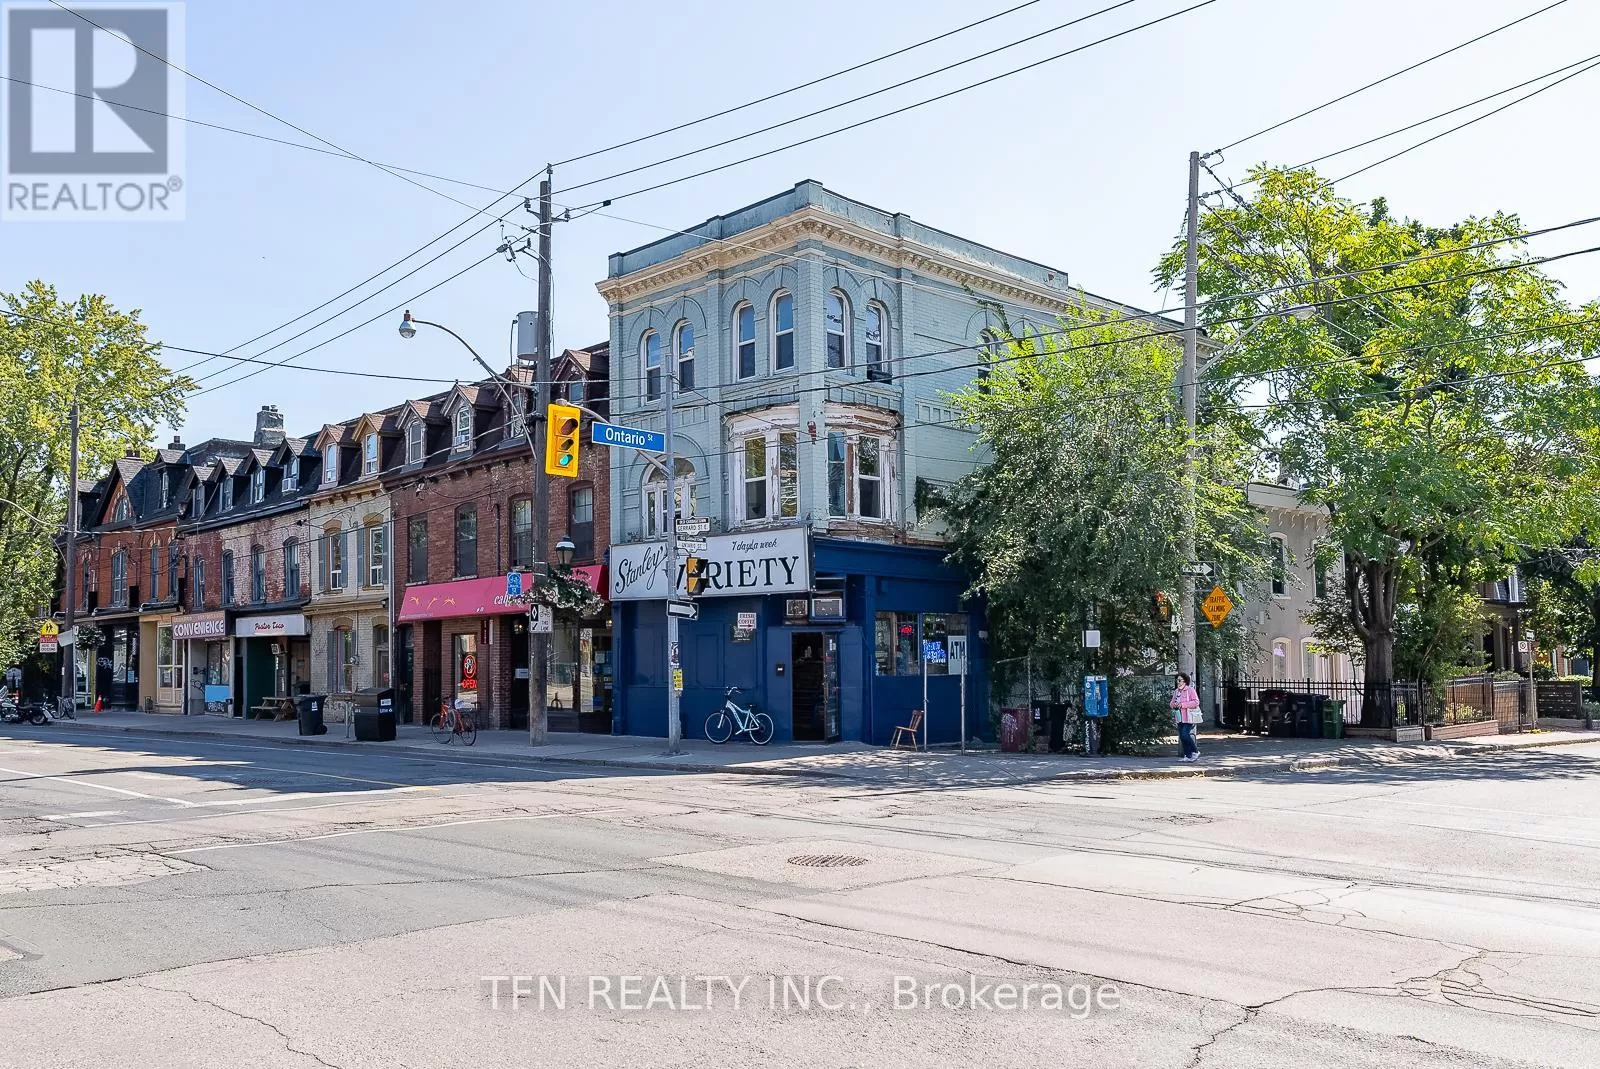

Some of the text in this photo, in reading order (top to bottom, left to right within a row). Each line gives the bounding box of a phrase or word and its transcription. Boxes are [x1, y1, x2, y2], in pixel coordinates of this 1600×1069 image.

[605, 427, 653, 446] Ontario St
[759, 537, 778, 549] week
[662, 555, 799, 592] VRIETY
[174, 620, 225, 637] CONVENIENCE
[461, 679, 478, 689] OPEN
